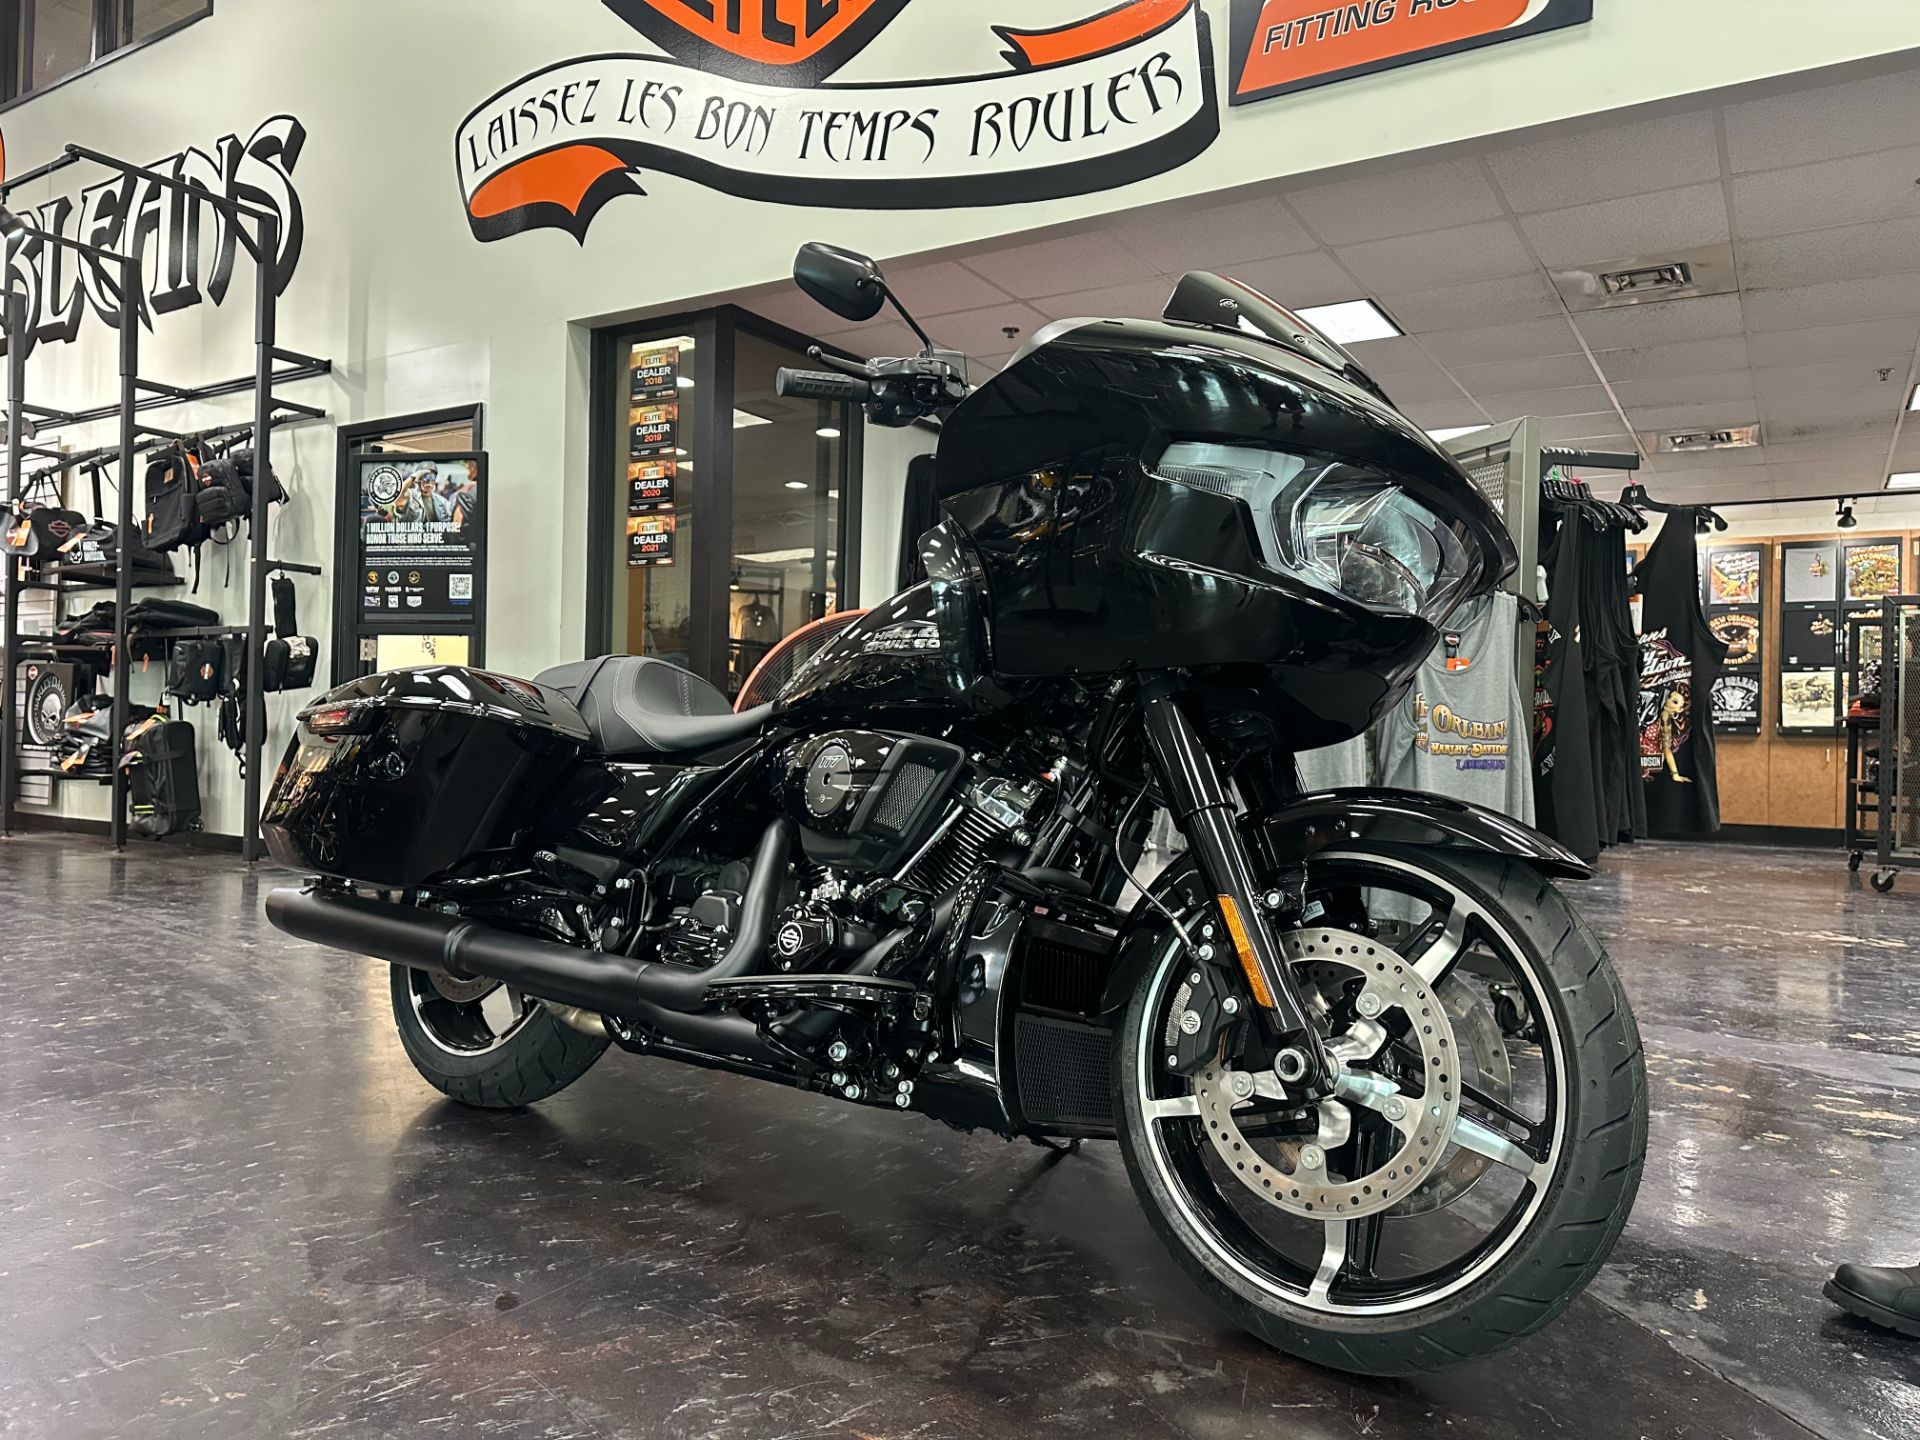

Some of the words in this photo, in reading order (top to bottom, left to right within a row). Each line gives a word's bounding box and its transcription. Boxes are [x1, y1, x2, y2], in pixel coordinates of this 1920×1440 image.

[1262, 0, 1395, 55] FITTING
[467, 78, 601, 173] LAISSEZ
[617, 78, 683, 134] LES
[694, 95, 777, 156] BON
[798, 108, 940, 164] TEMPS
[968, 51, 1183, 159] ROULER
[636, 366, 672, 379] DEALER
[644, 376, 663, 386] 2018
[635, 423, 671, 436] DEALER
[643, 433, 662, 443] 2019
[634, 478, 670, 490] DEALER
[641, 488, 661, 498] 2020
[371, 522, 395, 533] MILLION
[366, 533, 387, 544] HONOR
[388, 533, 407, 544] THOSE
[407, 533, 422, 543] WHO
[632, 533, 668, 545] DEALER
[641, 543, 659, 552] 2021
[872, 625, 940, 642] HARLE
[863, 637, 941, 653] DAVIDSO
